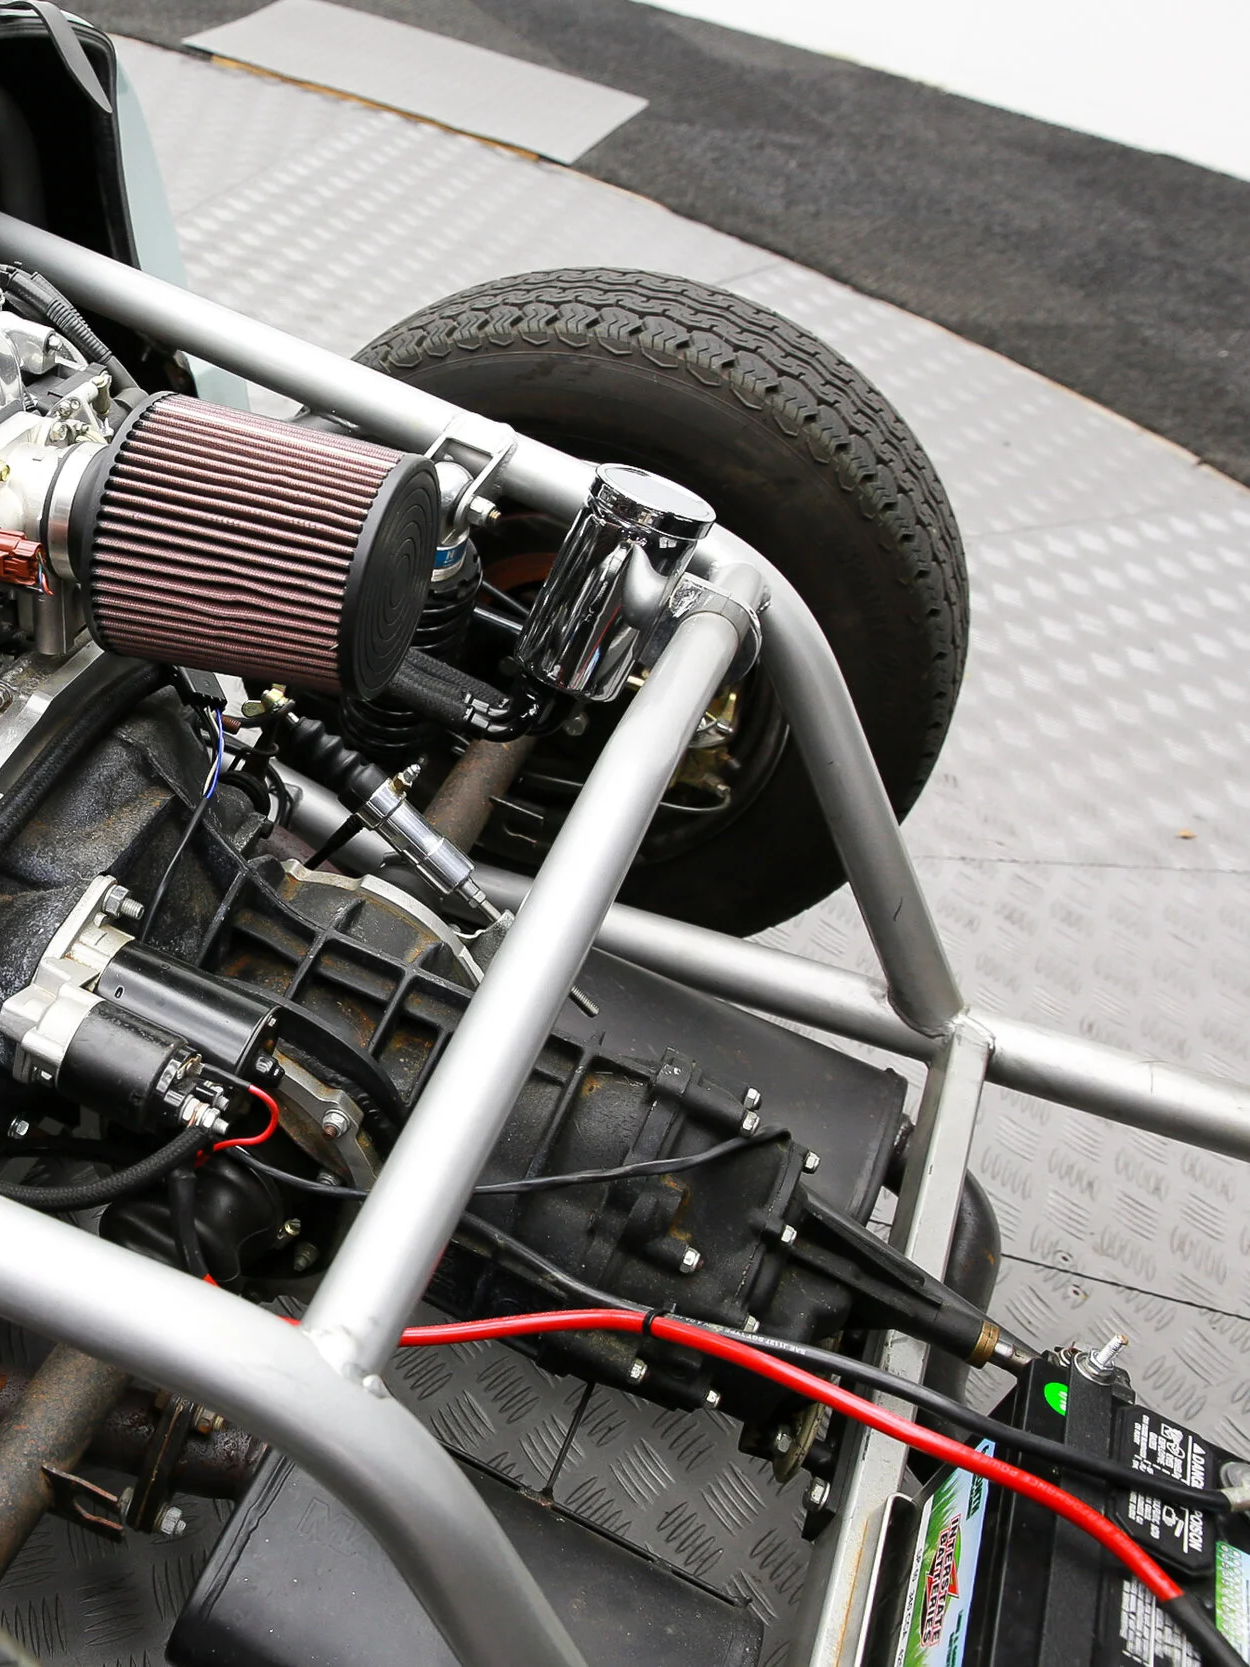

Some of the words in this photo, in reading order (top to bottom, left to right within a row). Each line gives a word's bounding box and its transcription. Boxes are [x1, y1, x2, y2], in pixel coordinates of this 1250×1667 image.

[1191, 1456, 1206, 1490] DANG
[922, 1531, 949, 1643] BATTERIES
[931, 1517, 960, 1642] INTERSTATE
